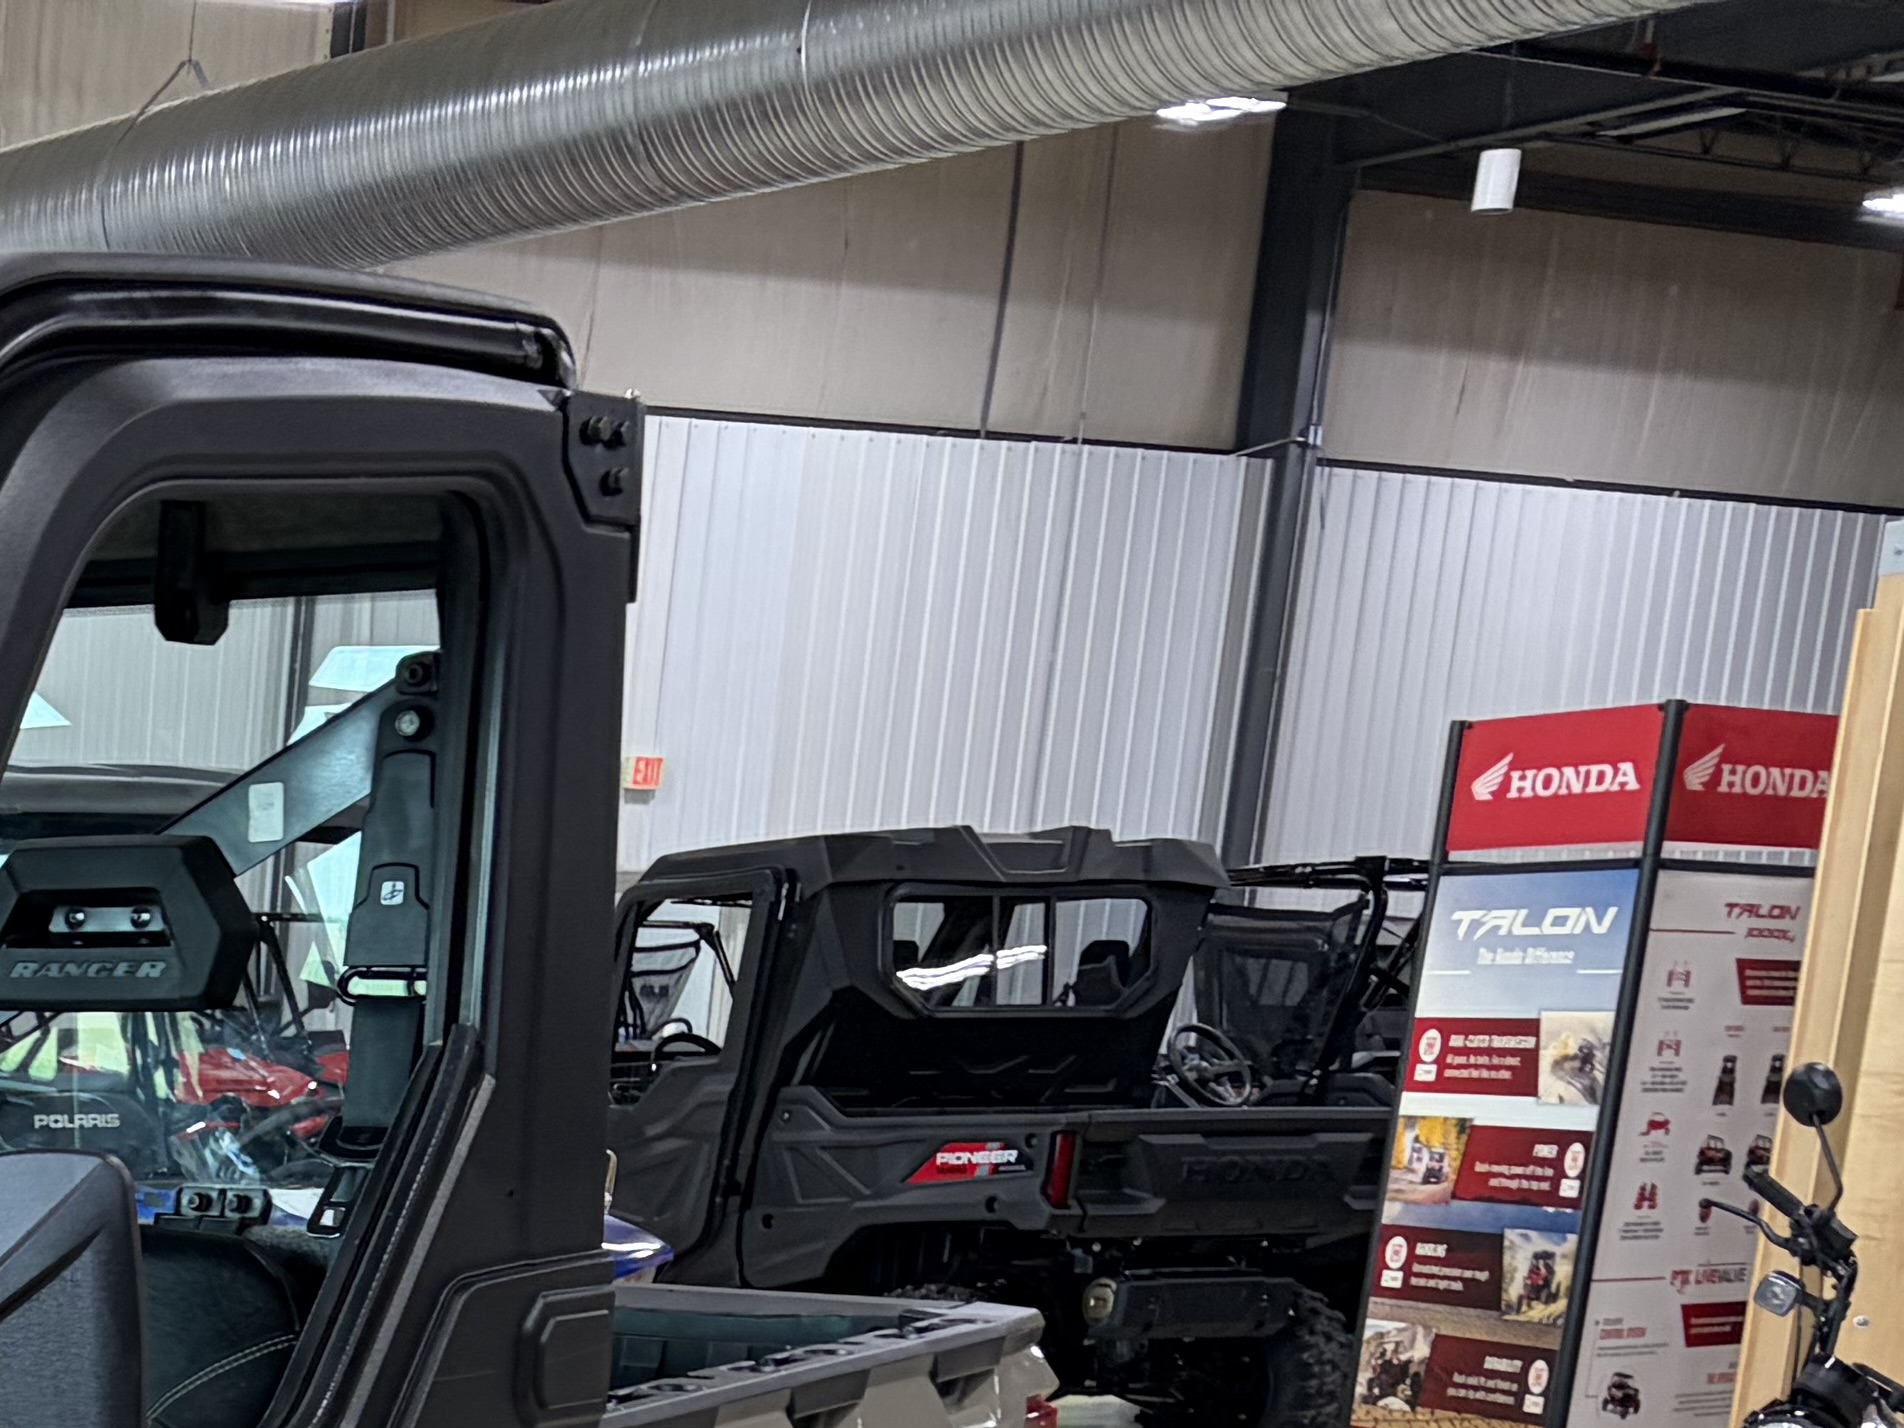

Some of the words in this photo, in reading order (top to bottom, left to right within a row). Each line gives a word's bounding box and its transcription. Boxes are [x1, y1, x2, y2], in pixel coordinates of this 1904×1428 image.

[1505, 761, 1641, 799] HONDA
[1716, 763, 1831, 799] HONDA
[1724, 902, 1801, 921] TALON
[1450, 906, 1619, 940] TALON
[9, 960, 168, 979] RANGER
[34, 1114, 120, 1129] POLARIS
[936, 1150, 1018, 1166] PIONEER
